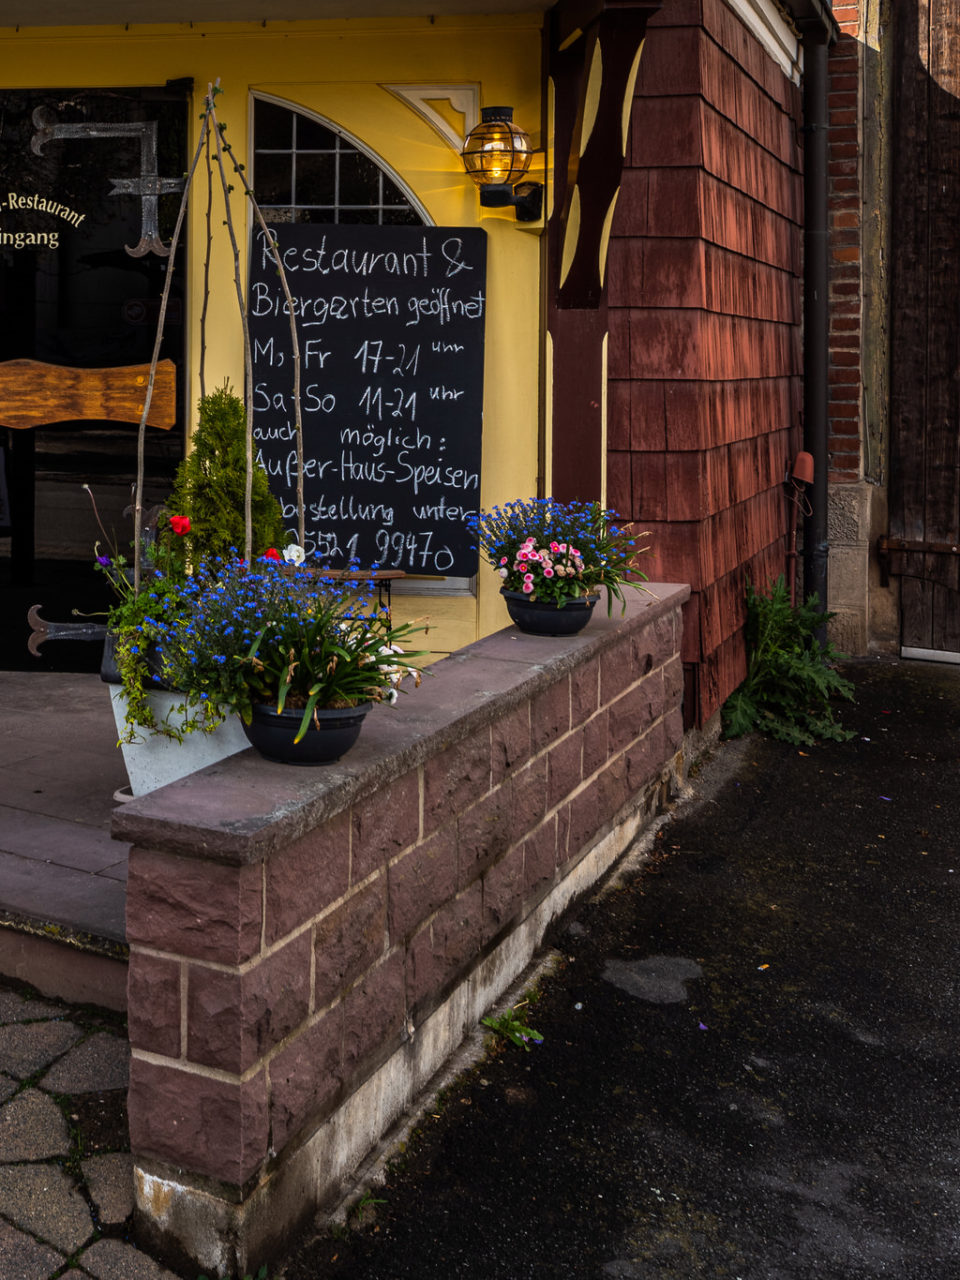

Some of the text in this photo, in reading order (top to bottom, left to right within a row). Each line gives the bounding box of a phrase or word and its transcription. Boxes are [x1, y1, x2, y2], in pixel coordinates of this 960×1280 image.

[256, 228, 432, 277] Restaurant
[251, 282, 486, 327] Biergarten geöffnet
[353, 340, 421, 377] 17-21
[358, 385, 418, 422] 11-21
[252, 420, 298, 441] auch
[412, 495, 477, 522] unter
[375, 528, 455, 571] 99470
